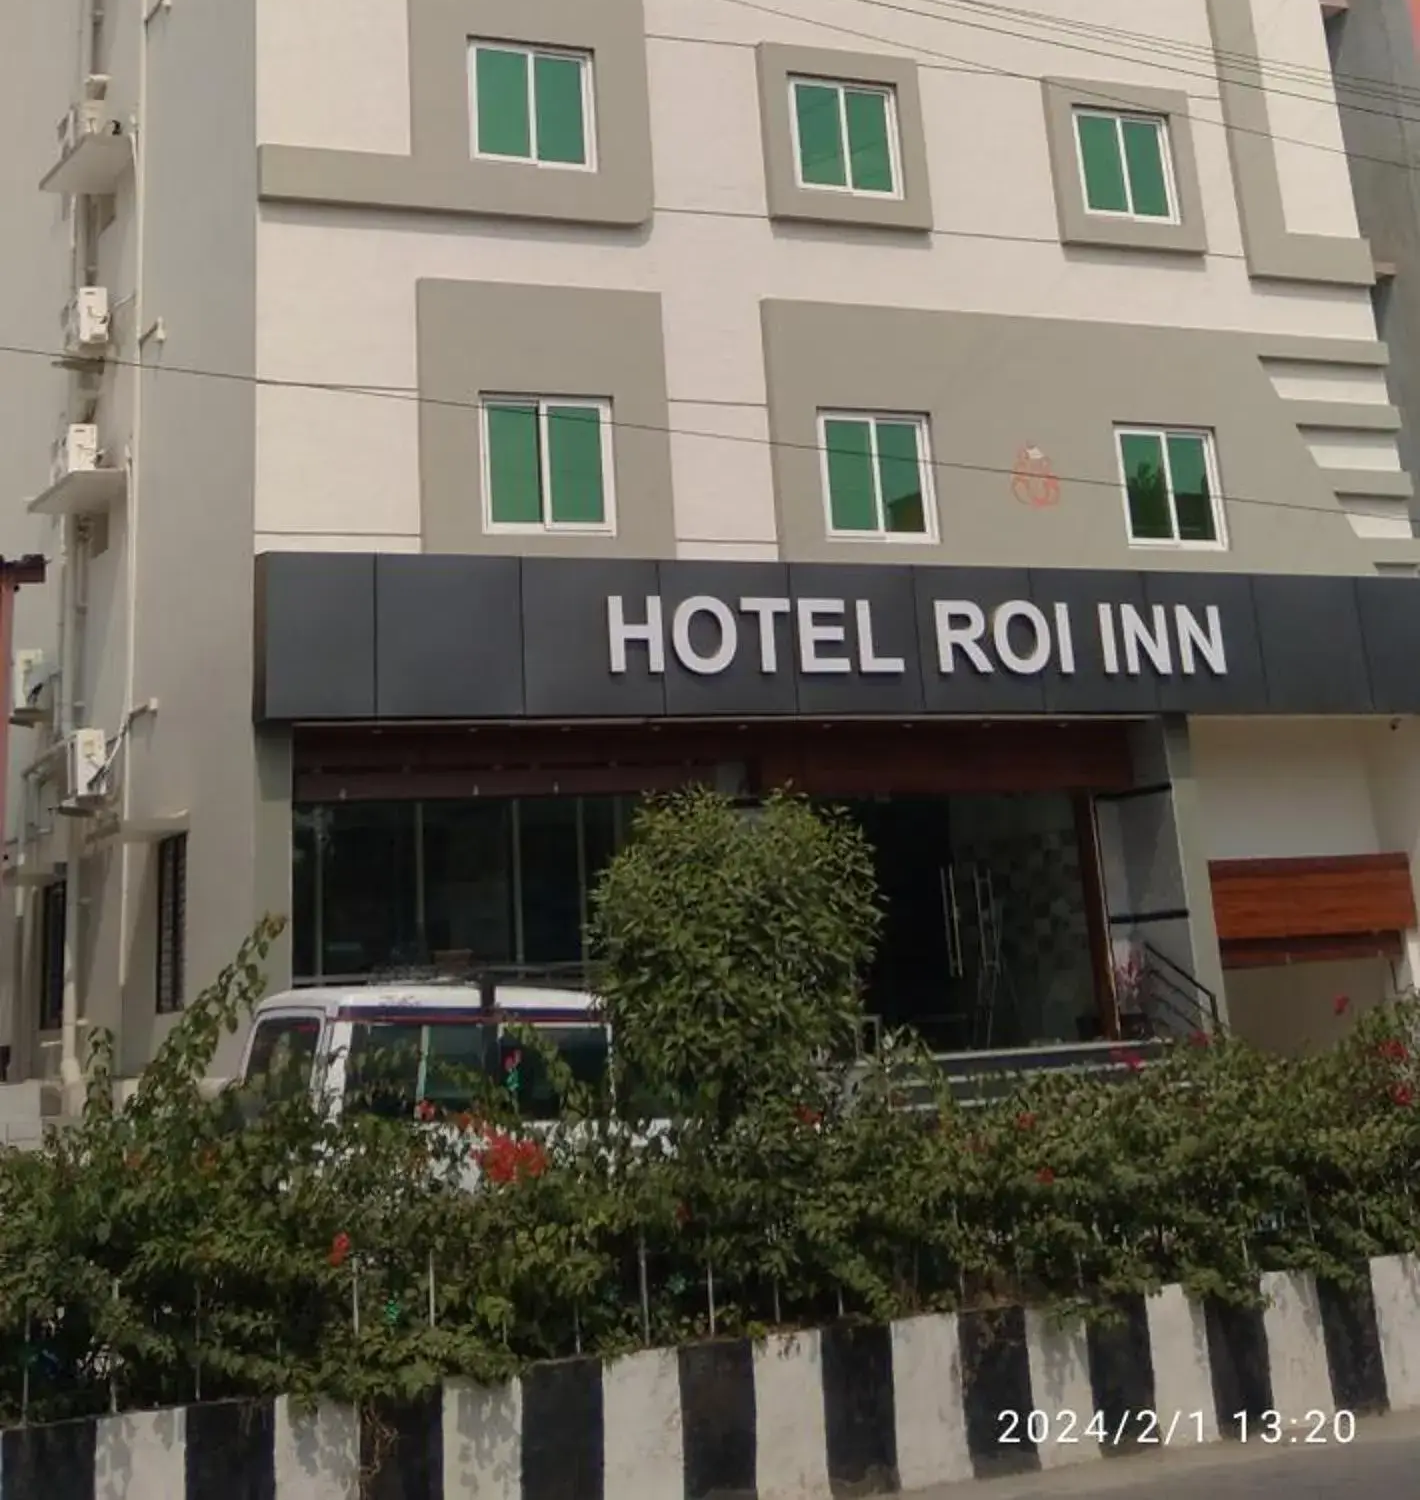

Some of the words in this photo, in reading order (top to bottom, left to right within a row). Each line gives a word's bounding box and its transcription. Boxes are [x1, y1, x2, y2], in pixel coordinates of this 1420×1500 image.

[607, 594, 905, 675] HOTEL
[933, 599, 1076, 675] ROI
[1098, 602, 1228, 676] INN
